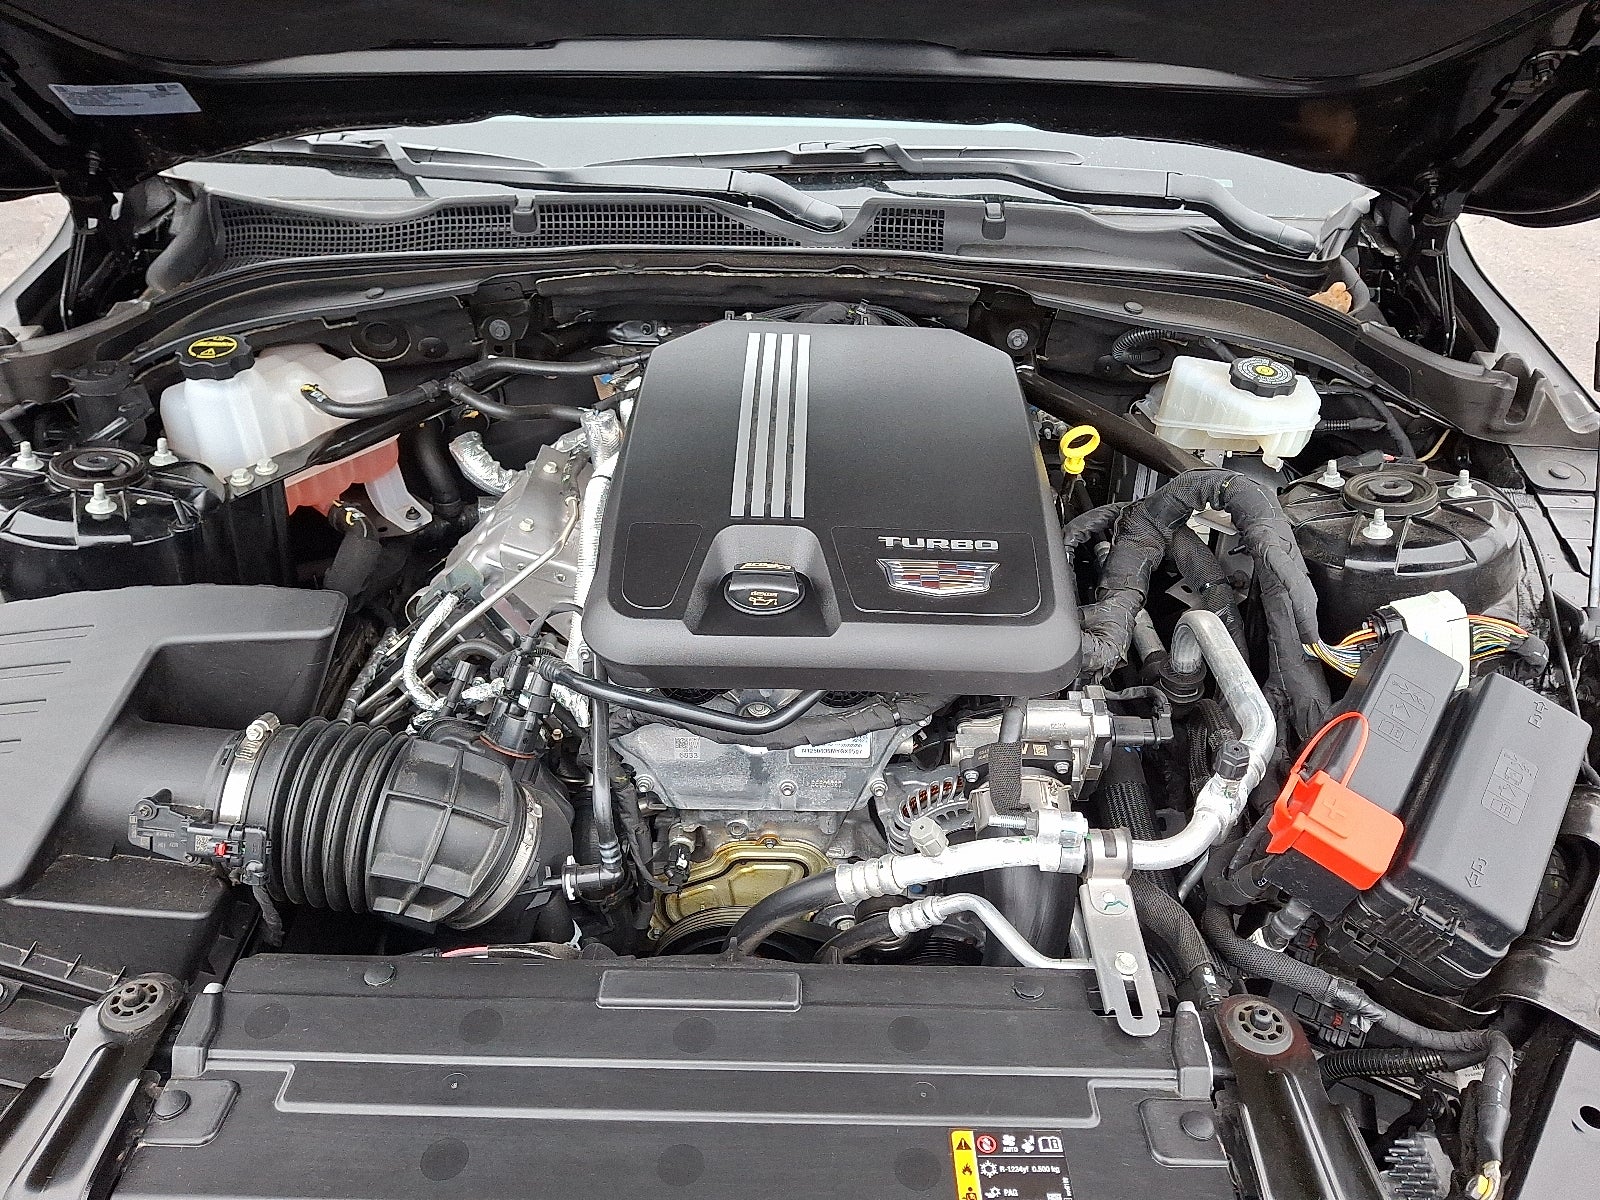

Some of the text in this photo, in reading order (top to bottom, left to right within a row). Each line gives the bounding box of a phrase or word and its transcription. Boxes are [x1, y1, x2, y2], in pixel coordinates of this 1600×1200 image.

[878, 536, 999, 550] TURBO
[999, 1165, 1061, 1175] R-1234yf 0.500 kg
[1003, 1188, 1019, 1197] PAG
